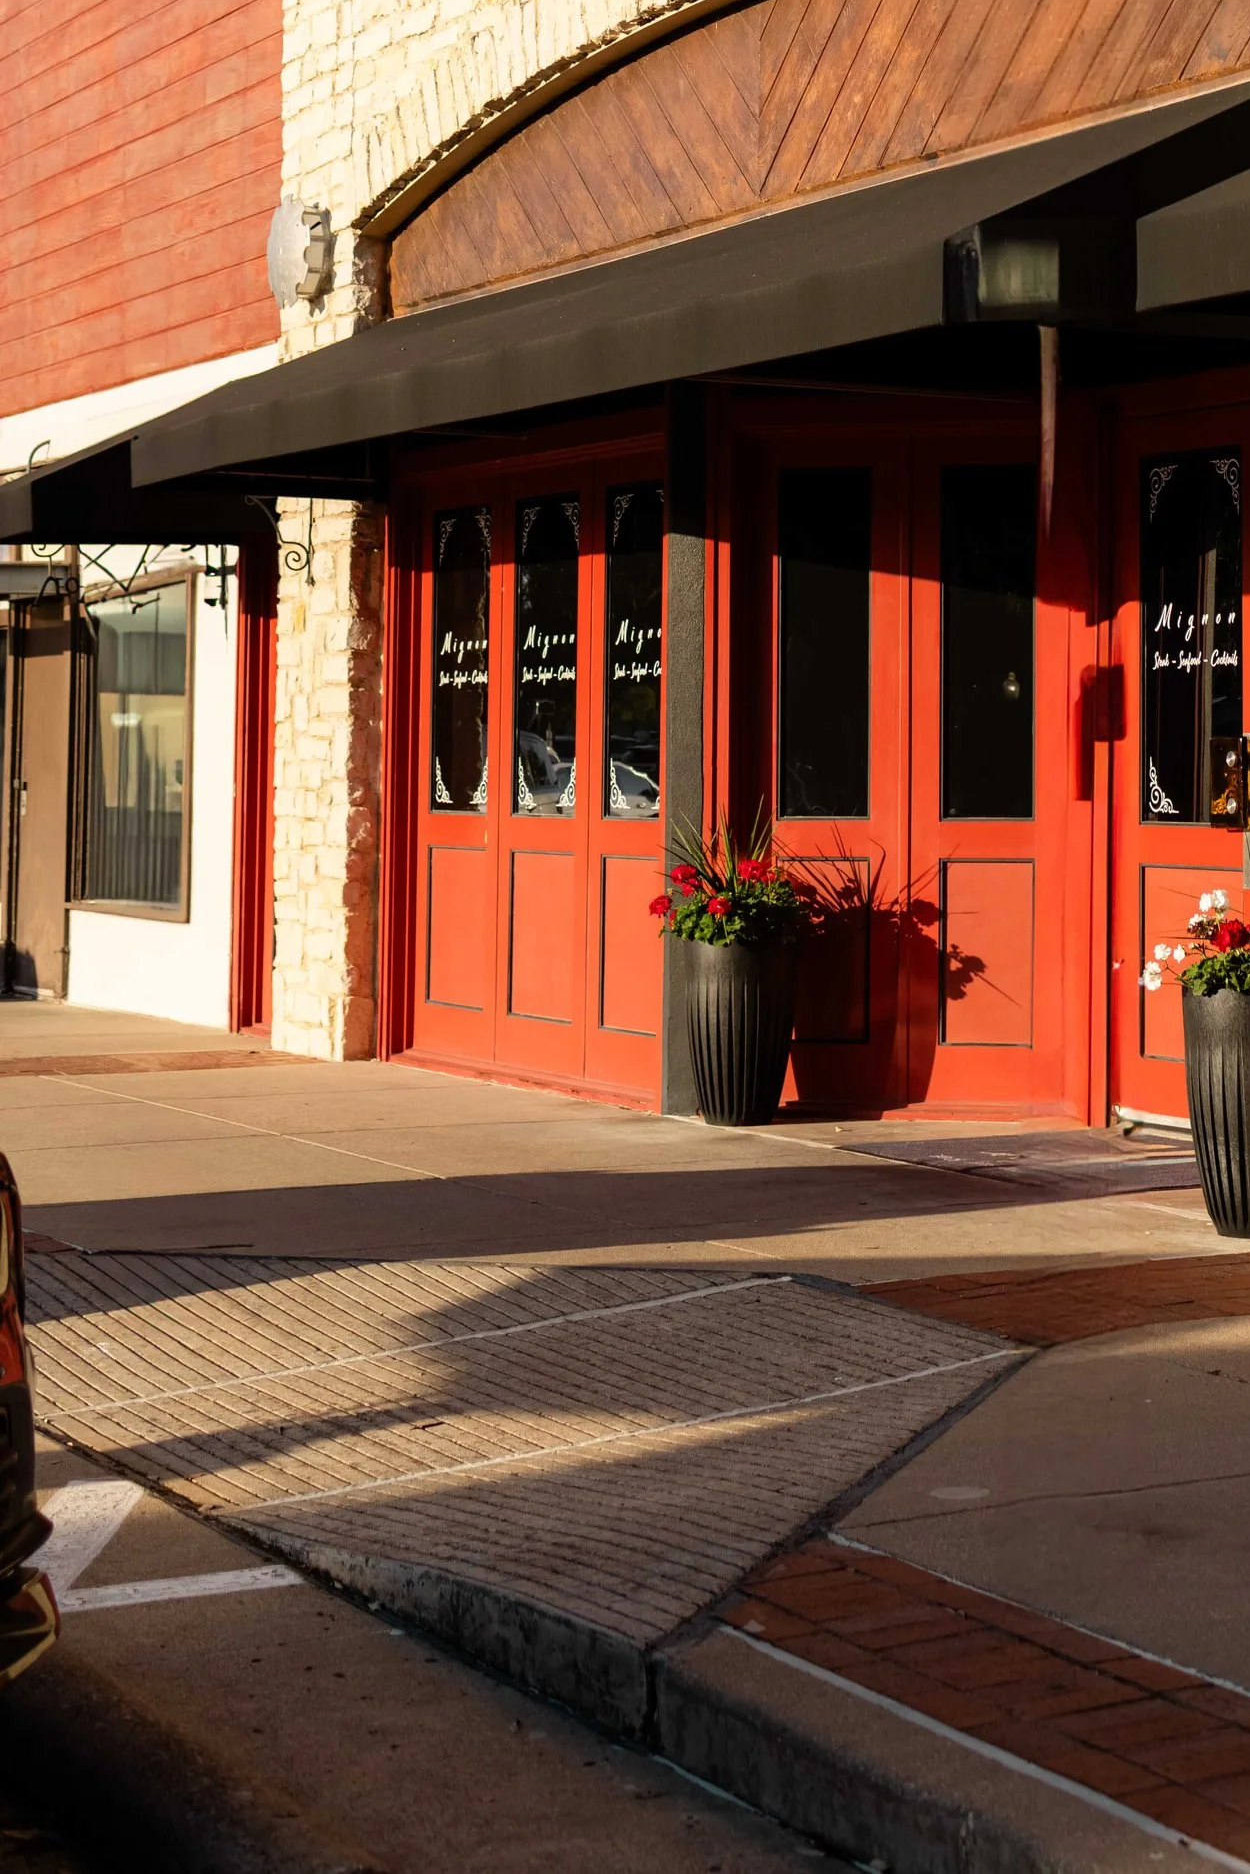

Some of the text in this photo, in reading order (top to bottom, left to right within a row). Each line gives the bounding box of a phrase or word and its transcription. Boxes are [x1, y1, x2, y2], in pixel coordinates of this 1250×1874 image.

[615, 618, 662, 654] Migno
[1154, 602, 1236, 642] Mignon
[523, 624, 575, 659] Mignon
[1177, 649, 1202, 673] Seafood
[1210, 648, 1238, 668] Cocktails
